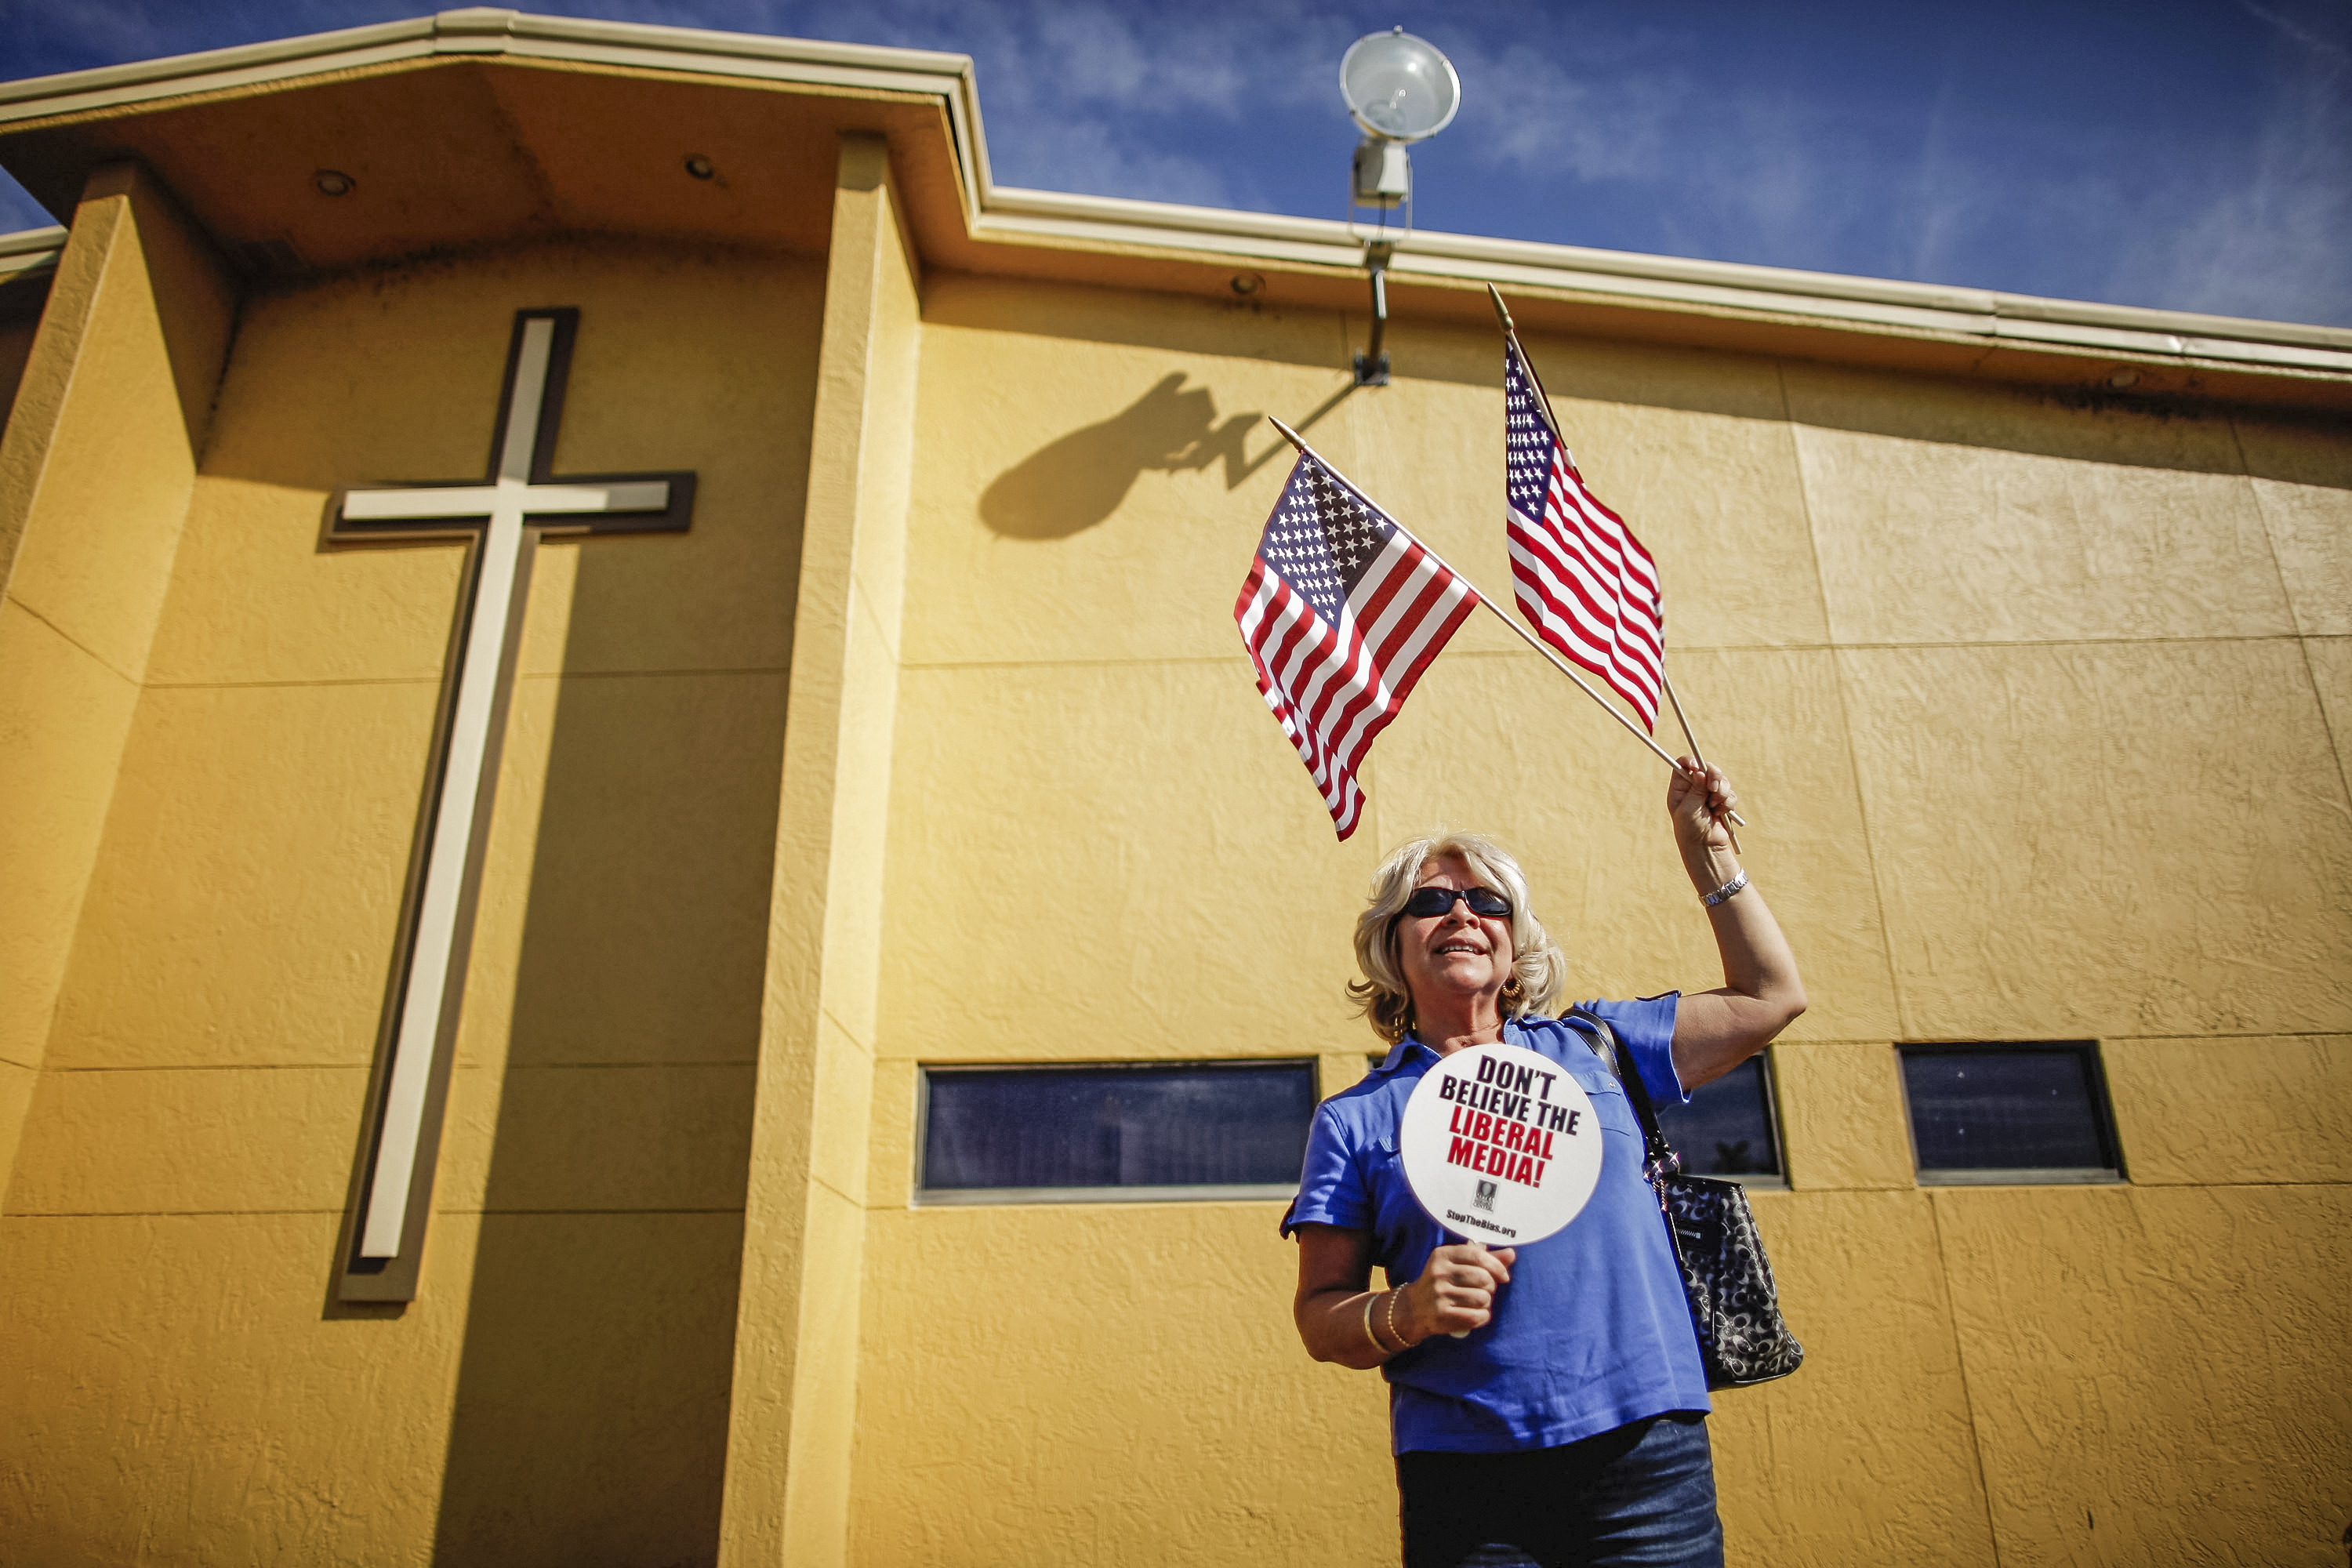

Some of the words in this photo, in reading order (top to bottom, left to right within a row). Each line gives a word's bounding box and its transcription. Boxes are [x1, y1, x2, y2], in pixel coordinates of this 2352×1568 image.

[1476, 1054, 1556, 1100] DON'T
[1439, 1074, 1532, 1122] BELIEVE
[1537, 1101, 1581, 1136] THE
[1449, 1105, 1554, 1160] LIBERAL
[1446, 1136, 1545, 1189] MEDIA!
[1446, 1209, 1516, 1238] StopTheBias.org
